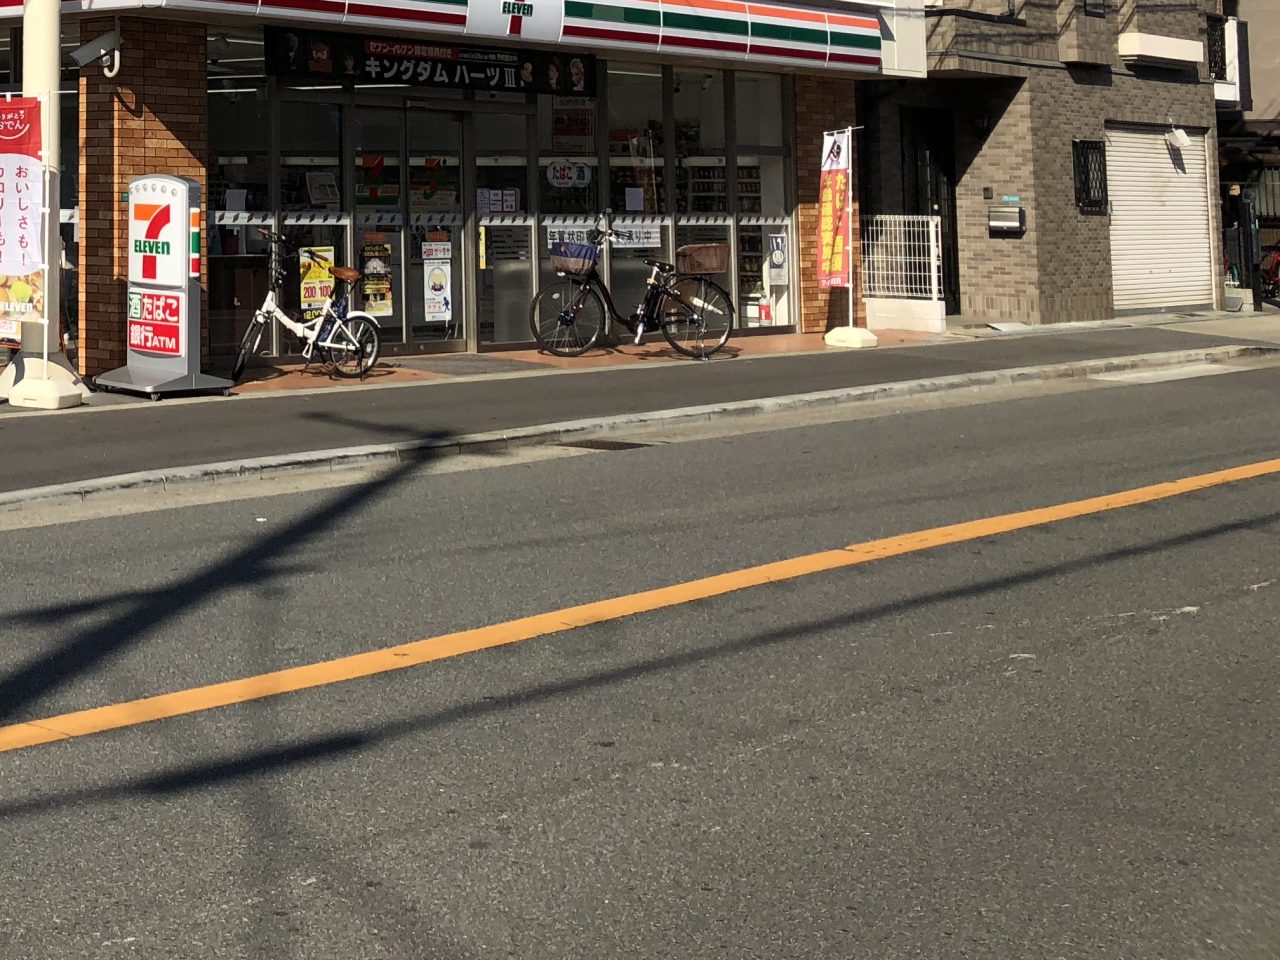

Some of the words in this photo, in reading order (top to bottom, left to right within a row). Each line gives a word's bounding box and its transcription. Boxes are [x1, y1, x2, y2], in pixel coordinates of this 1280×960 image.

[365, 57, 449, 84] キングダム
[552, 166, 573, 181] たばこ
[304, 286, 317, 299] 200
[128, 295, 141, 320] 酒
[142, 296, 179, 322] たばこ
[129, 323, 176, 349] 銀行ATM
